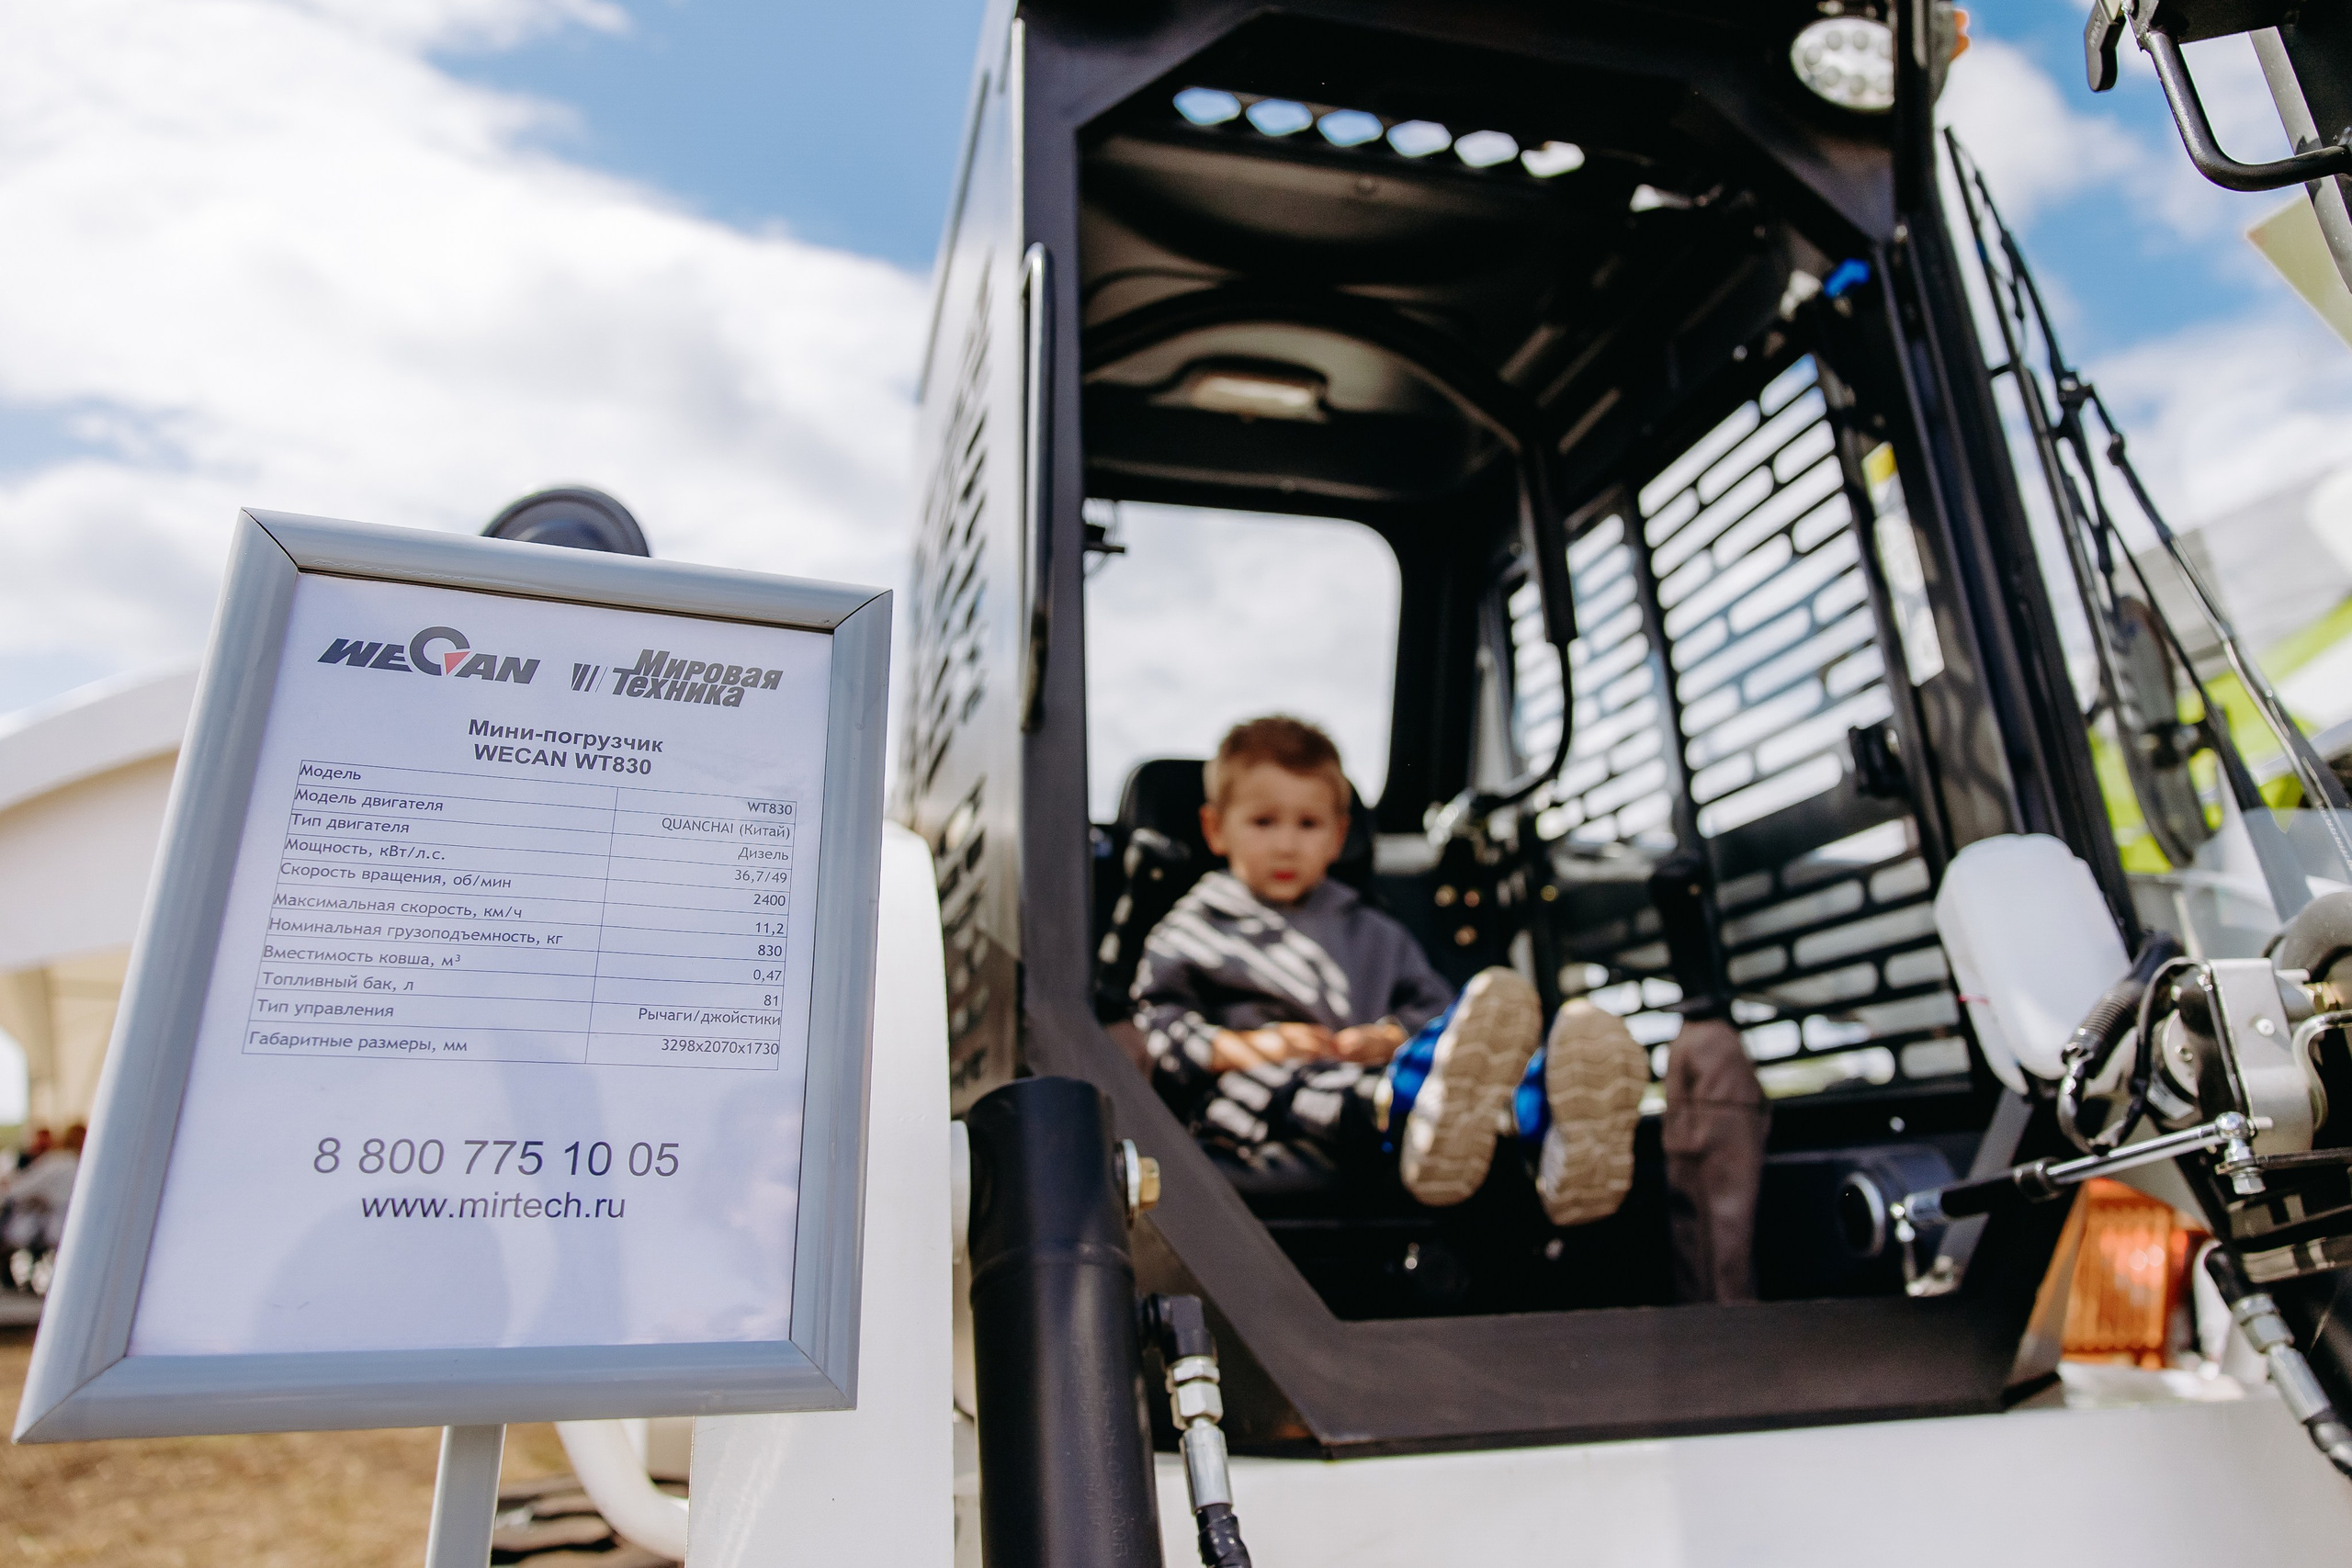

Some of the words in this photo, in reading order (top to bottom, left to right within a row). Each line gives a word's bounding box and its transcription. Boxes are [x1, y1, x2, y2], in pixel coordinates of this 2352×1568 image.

[316, 626, 541, 685] WECAN
[633, 649, 785, 691] Мировая
[611, 667, 746, 708] Техника
[468, 718, 664, 754] Мини-погрузчик
[473, 743, 567, 769] WECAN
[574, 753, 652, 775] WT830
[299, 763, 362, 782] Модель
[294, 788, 357, 807] Модель
[361, 795, 444, 812] двигателя
[747, 801, 793, 816] WT830
[291, 813, 322, 828] Тип
[325, 818, 411, 834] двигателя
[662, 818, 734, 834] QUANCHAI
[739, 824, 791, 840] (Китай)
[284, 838, 373, 858] Мощность,
[379, 845, 447, 862] кВт/л.с.
[737, 847, 789, 862] Дизель
[280, 862, 356, 880] Скорость
[361, 869, 447, 886] вращения,
[452, 874, 512, 889] об/мин
[734, 869, 788, 885] 36,7/49
[273, 893, 396, 912] Максимальная
[400, 901, 478, 919] скорость,
[483, 906, 524, 919] км/ч
[753, 893, 786, 908] 2400
[268, 917, 382, 938] Номинальная
[386, 926, 541, 946] грузоподъемность,
[546, 934, 563, 946] кг
[754, 921, 786, 937] 11,2
[263, 944, 374, 964] Вместимость
[379, 953, 435, 968] ковша,
[757, 943, 783, 958] 830
[263, 971, 358, 989] Топливный
[362, 976, 397, 993] бак,
[402, 979, 414, 992] л
[752, 968, 783, 985] 0,47
[257, 998, 289, 1014] Тип
[293, 1001, 395, 1019] управления
[763, 994, 780, 1008] 81
[638, 1008, 781, 1027] Рычаги/джойстики
[248, 1031, 354, 1052] Габаритные
[357, 1039, 437, 1055] размеры,
[442, 1042, 469, 1054] мм
[313, 1136, 342, 1174] 8
[358, 1138, 445, 1176] 800
[463, 1139, 544, 1177] 775
[563, 1141, 613, 1177] 10
[628, 1142, 680, 1177] 05
[360, 1191, 627, 1220] www.mirtech.ru
